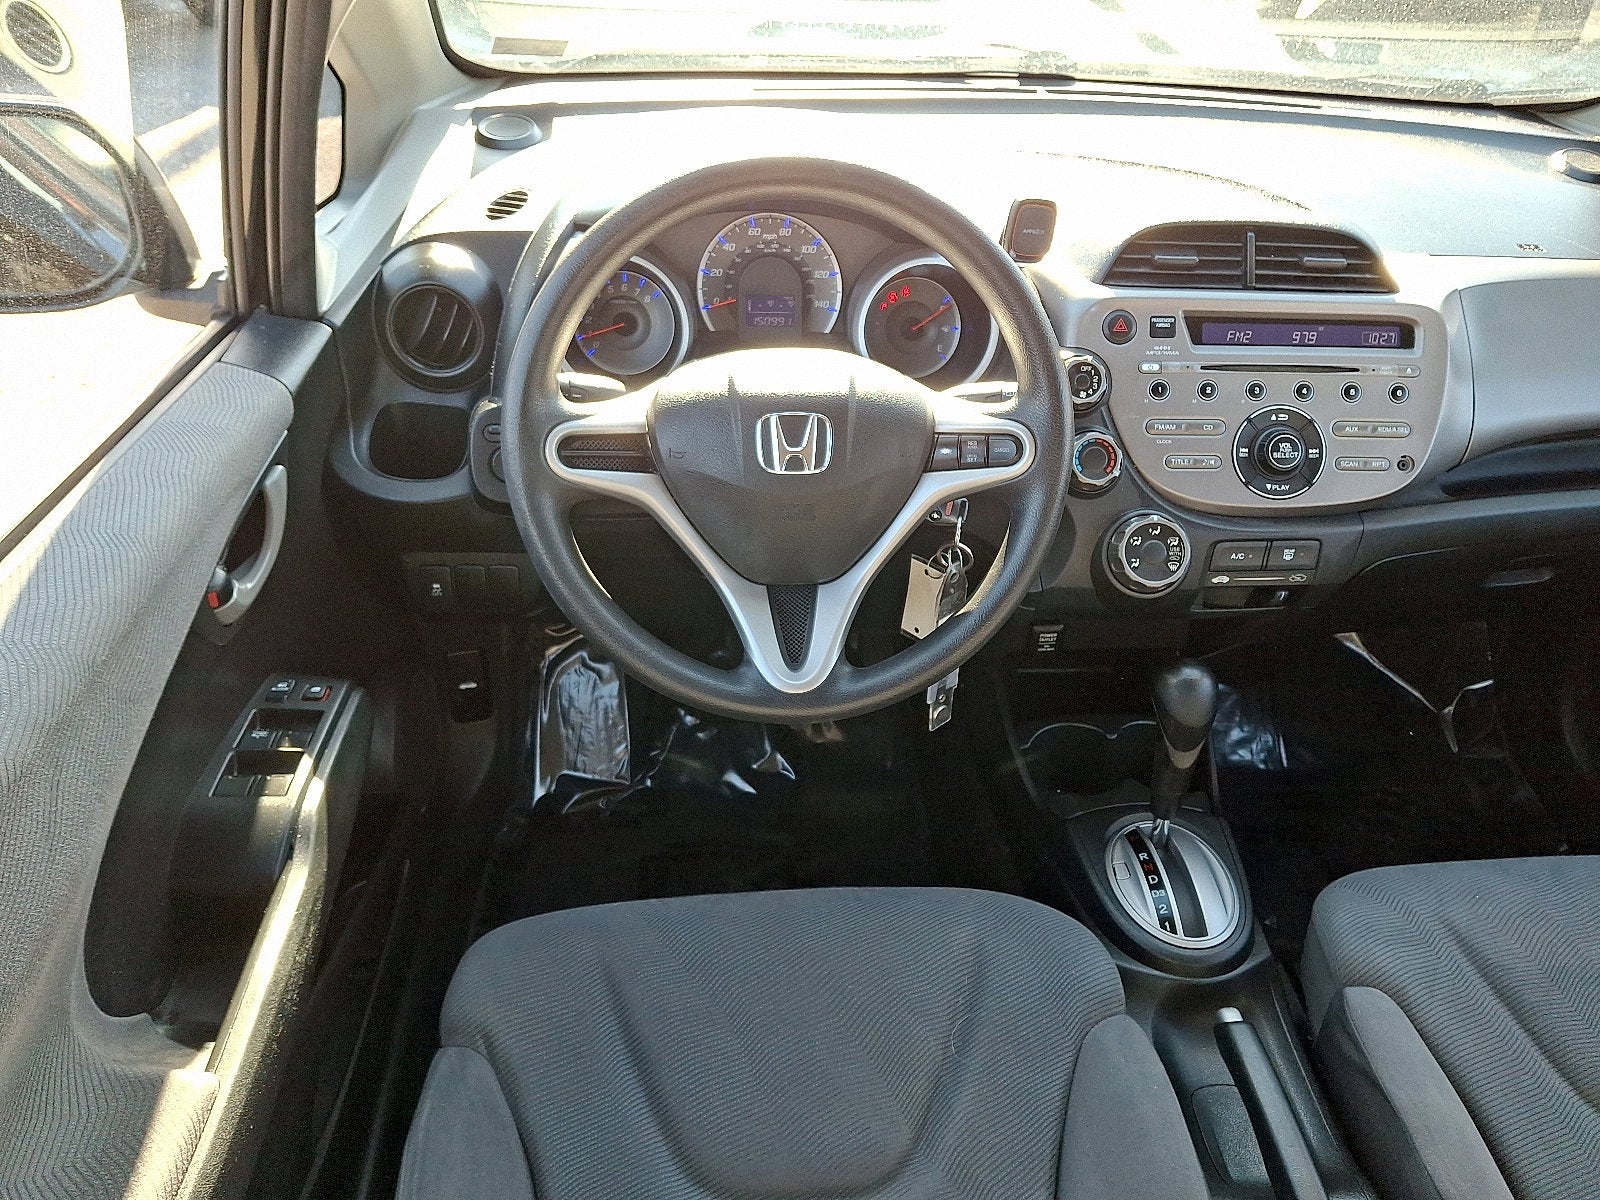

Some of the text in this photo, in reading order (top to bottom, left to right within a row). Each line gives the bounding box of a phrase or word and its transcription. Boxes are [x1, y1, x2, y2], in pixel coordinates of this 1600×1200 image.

[748, 228, 761, 236] 60
[779, 228, 792, 236] 80
[722, 243, 736, 251] 40
[801, 246, 817, 254] 100
[710, 269, 723, 277] 20
[814, 271, 829, 279] 120
[608, 285, 614, 293] 5
[621, 283, 628, 291] 6
[633, 288, 640, 297] 7
[814, 301, 829, 309] 140
[1226, 330, 1253, 343] FM2
[593, 341, 600, 349] 0
[1087, 388, 1094, 396] 4
[1158, 386, 1162, 394] 1
[1205, 386, 1212, 394] 2
[1349, 388, 1356, 396] 5
[1138, 852, 1149, 861] R
[1143, 862, 1154, 872] N
[1148, 875, 1158, 885] D
[1151, 889, 1166, 898] D3
[1158, 904, 1168, 914] 2
[1164, 921, 1170, 932] 1
